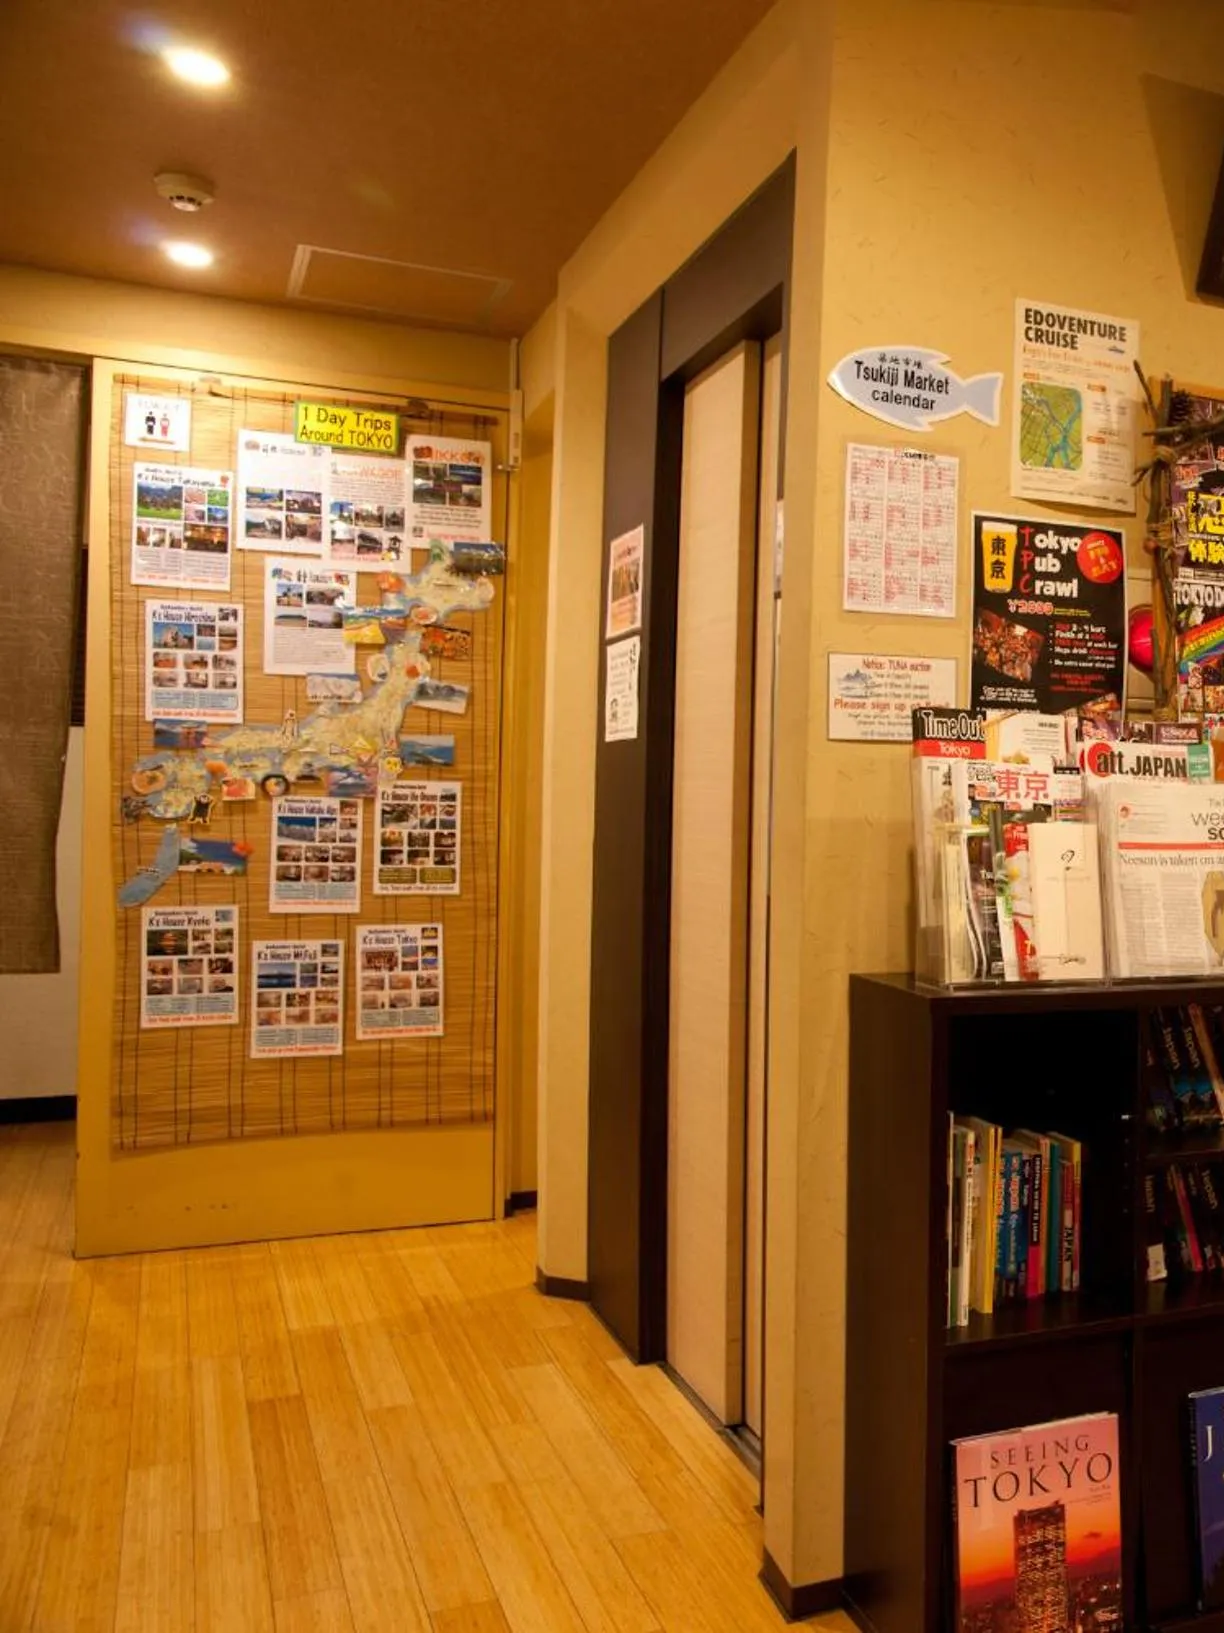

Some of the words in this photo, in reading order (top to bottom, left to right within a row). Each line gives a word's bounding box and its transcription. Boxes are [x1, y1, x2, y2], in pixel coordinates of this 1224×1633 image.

[1024, 307, 1128, 343] EDOVENTURE
[1024, 326, 1080, 350] CRUISE
[854, 360, 899, 386] Tsukiji
[903, 370, 950, 396] Market
[871, 387, 937, 412] calendar
[316, 407, 347, 428] Day
[353, 411, 392, 431] Trips
[300, 424, 344, 443] Around
[348, 429, 394, 449] TOKYO
[834, 698, 867, 710] Please
[872, 701, 891, 713] sign
[939, 741, 971, 757] Tokyo
[994, 768, 1050, 801] 東京
[989, 1434, 1090, 1470] SEEING
[963, 1452, 1113, 1509] TOKYO
